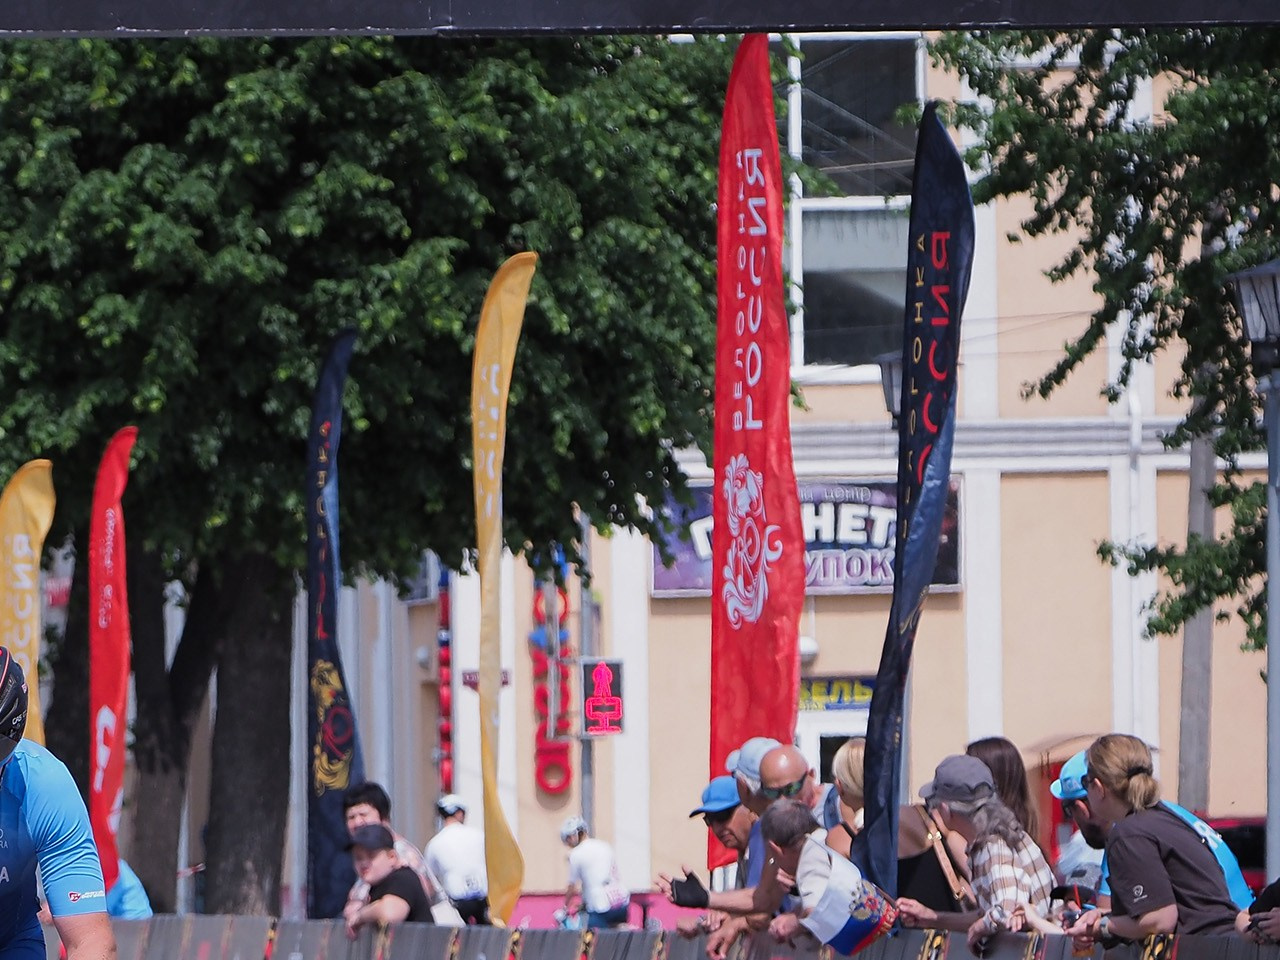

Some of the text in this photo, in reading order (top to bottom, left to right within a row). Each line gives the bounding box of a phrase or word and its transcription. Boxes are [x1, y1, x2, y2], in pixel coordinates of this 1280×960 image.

[917, 231, 951, 485] ССИЯ
[11, 533, 34, 675] ОССИЯ
[805, 548, 896, 586] УПОК
